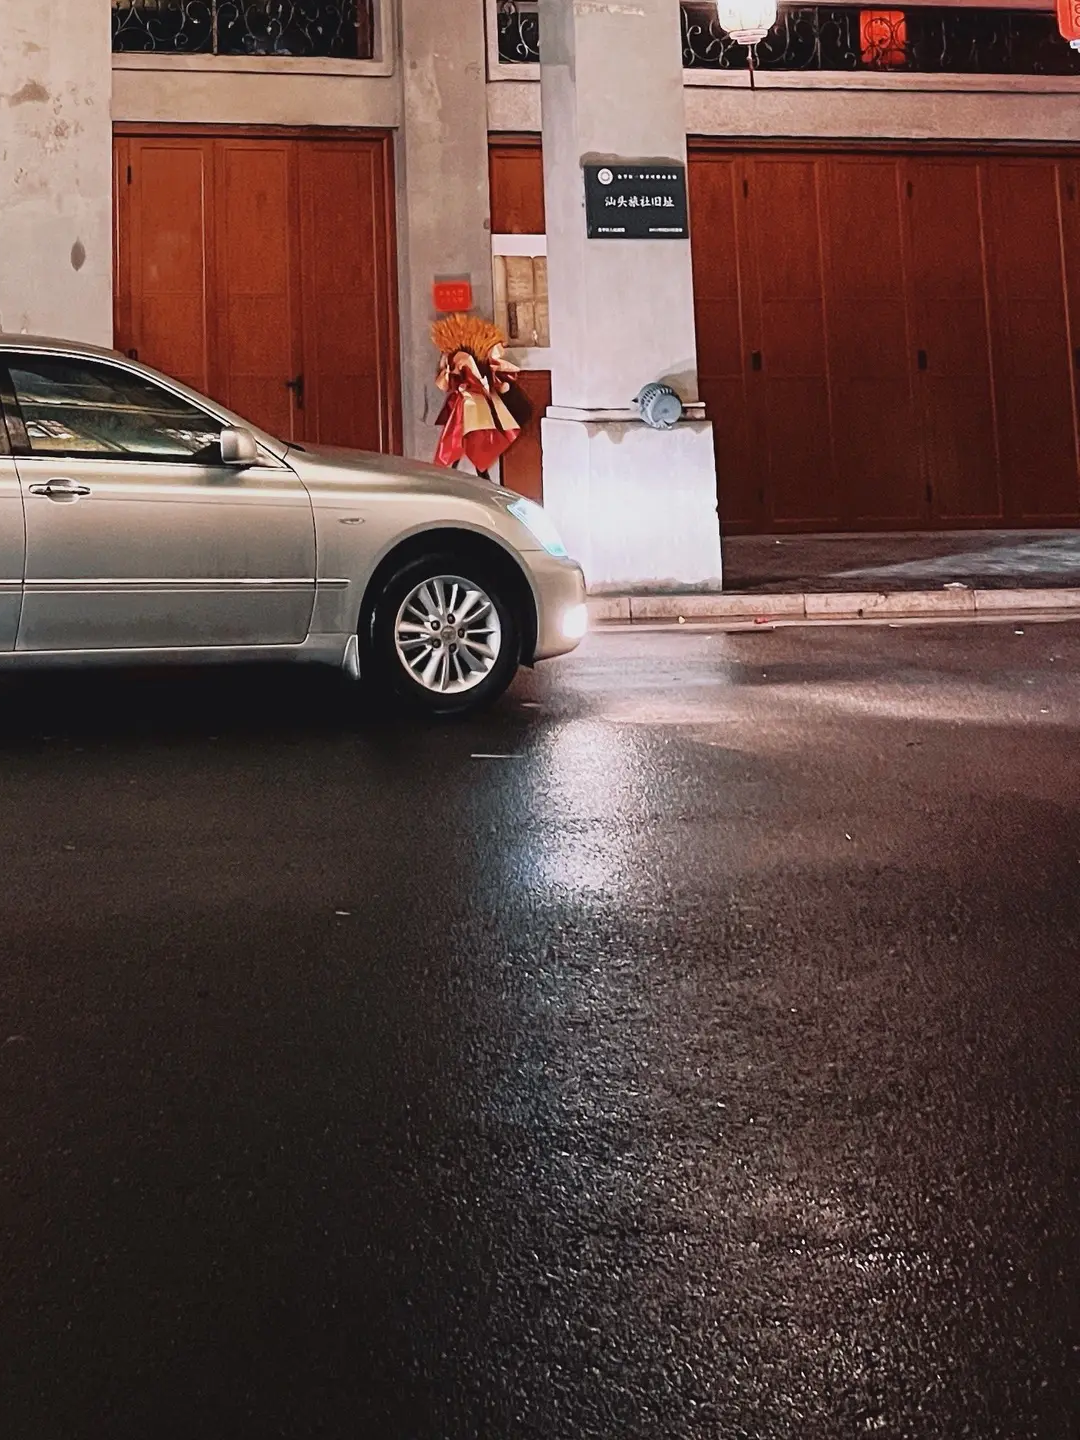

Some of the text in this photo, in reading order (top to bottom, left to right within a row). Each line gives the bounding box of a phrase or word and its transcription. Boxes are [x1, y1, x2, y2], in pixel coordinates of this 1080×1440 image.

[604, 195, 675, 208] 汕头旅社旧址
